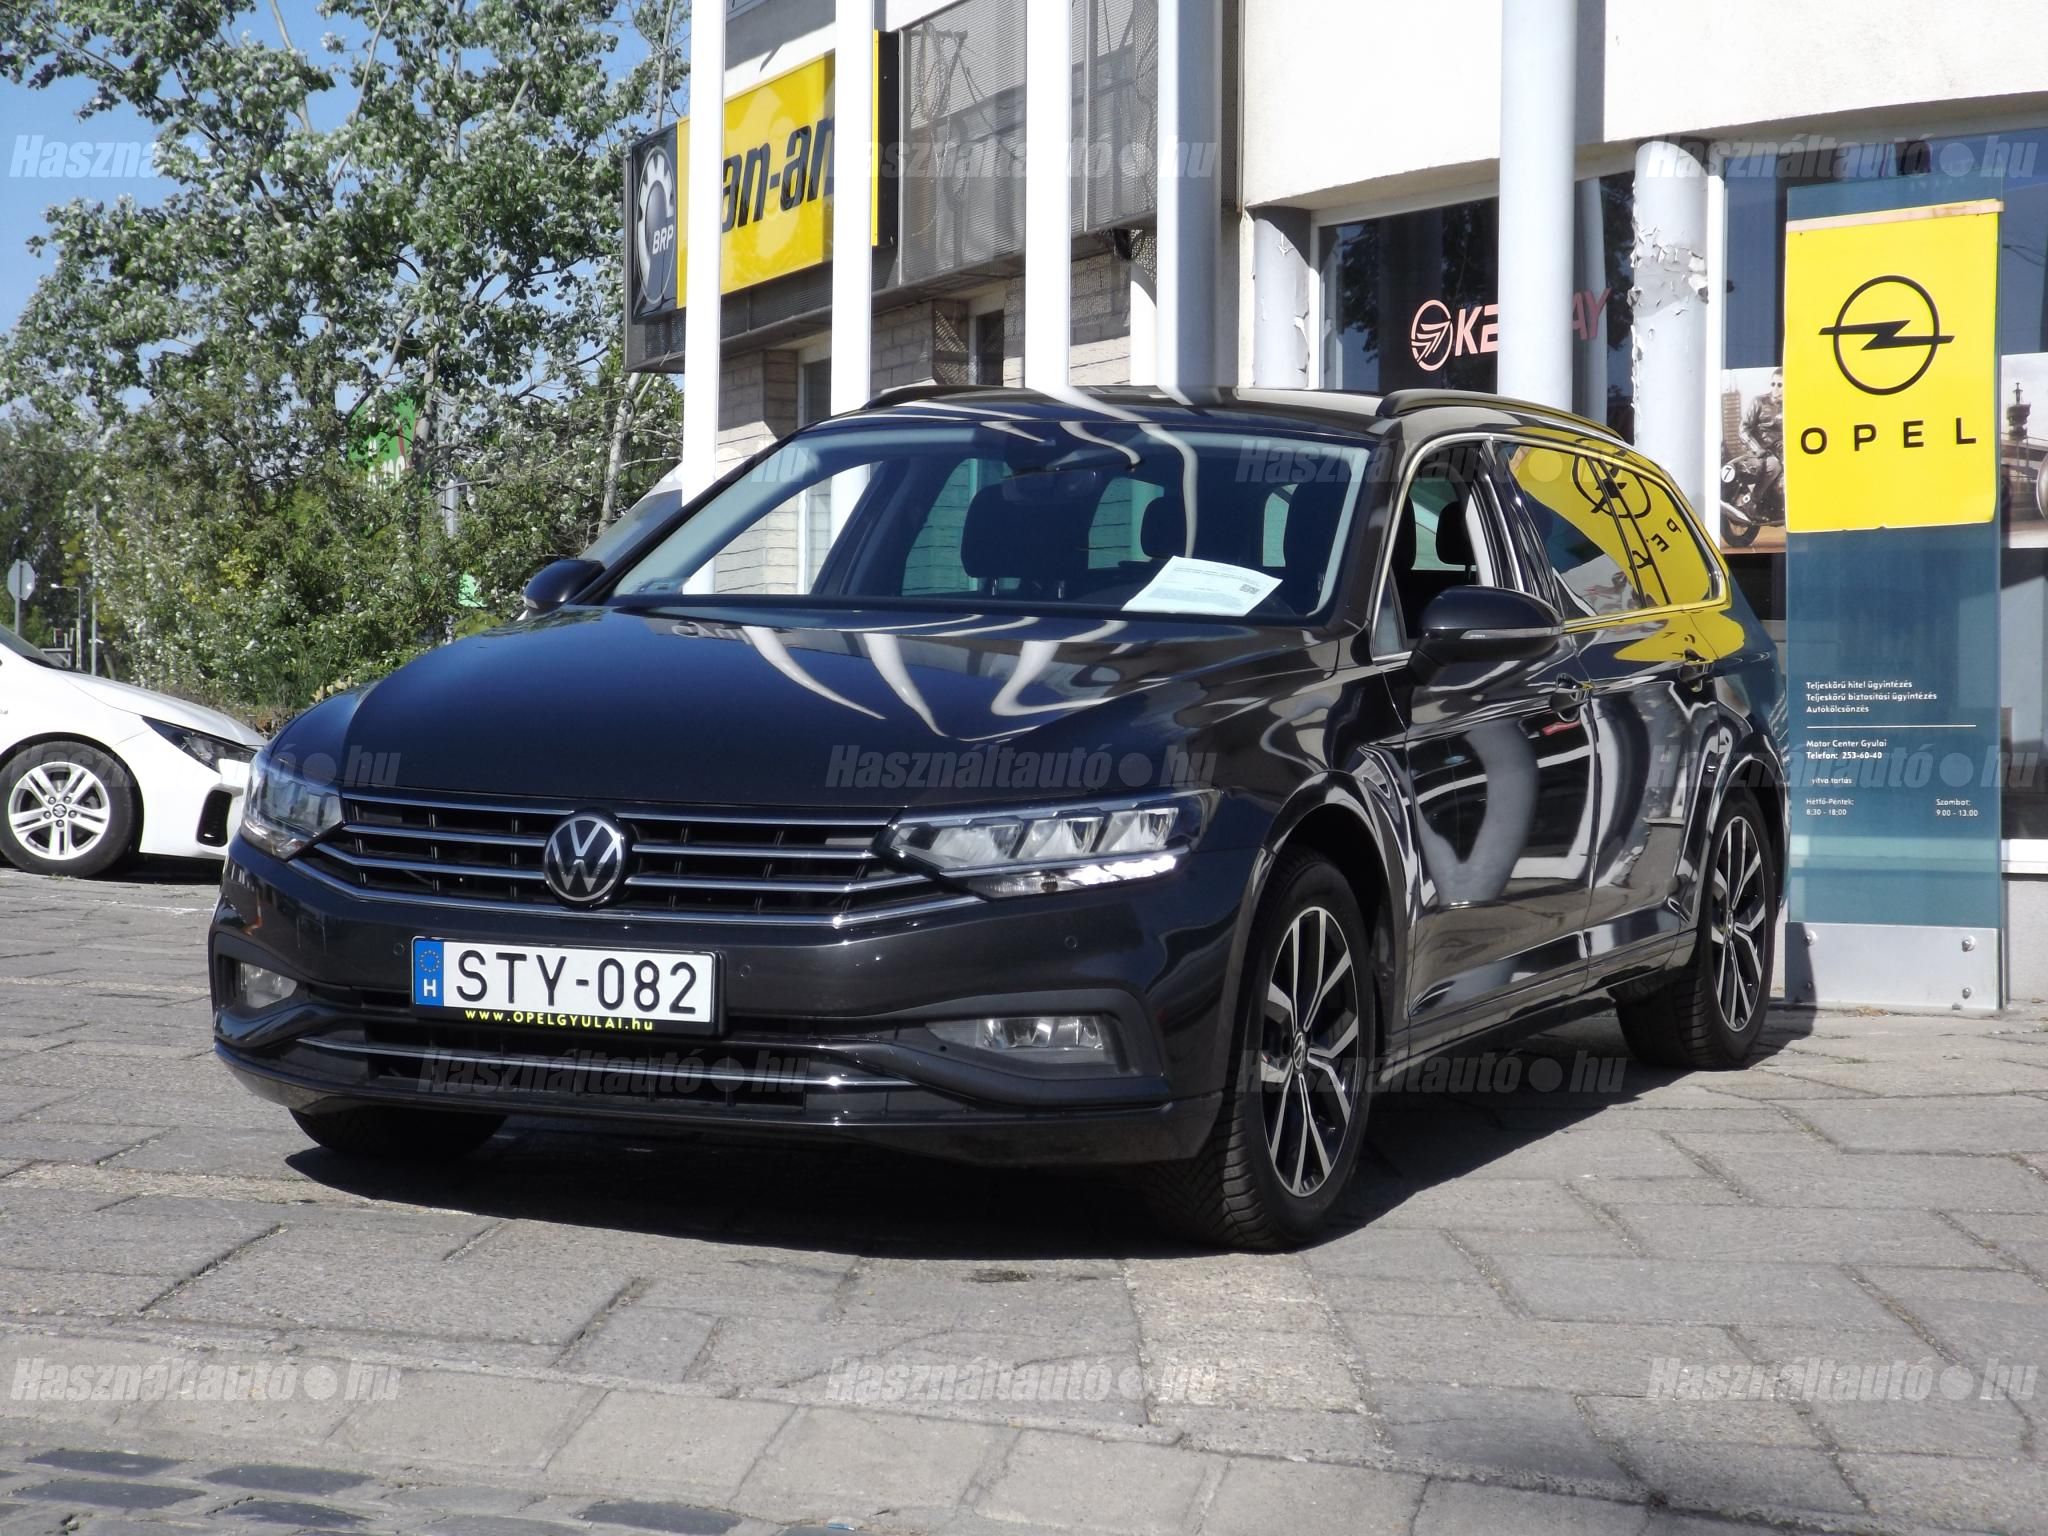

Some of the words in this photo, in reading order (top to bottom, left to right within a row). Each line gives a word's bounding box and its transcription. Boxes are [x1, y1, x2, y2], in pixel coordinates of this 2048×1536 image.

[652, 224, 674, 255] BRP
[1455, 288, 1611, 356] KEAY
[1801, 418, 1977, 455] OPEL
[1847, 680, 1866, 689] hitel
[1868, 680, 1913, 690] ügyintézés
[1892, 691, 1937, 702] ügyintézés
[1806, 704, 1870, 714] Autókölcsönzés
[1806, 739, 1831, 748] Motor
[1832, 739, 1859, 748] Center
[1861, 738, 1887, 749] Gyulai
[1806, 751, 1838, 760] Telefon:
[1842, 751, 1883, 760] 253-60-40
[423, 978, 437, 998] H
[456, 949, 697, 1015] STY-082
